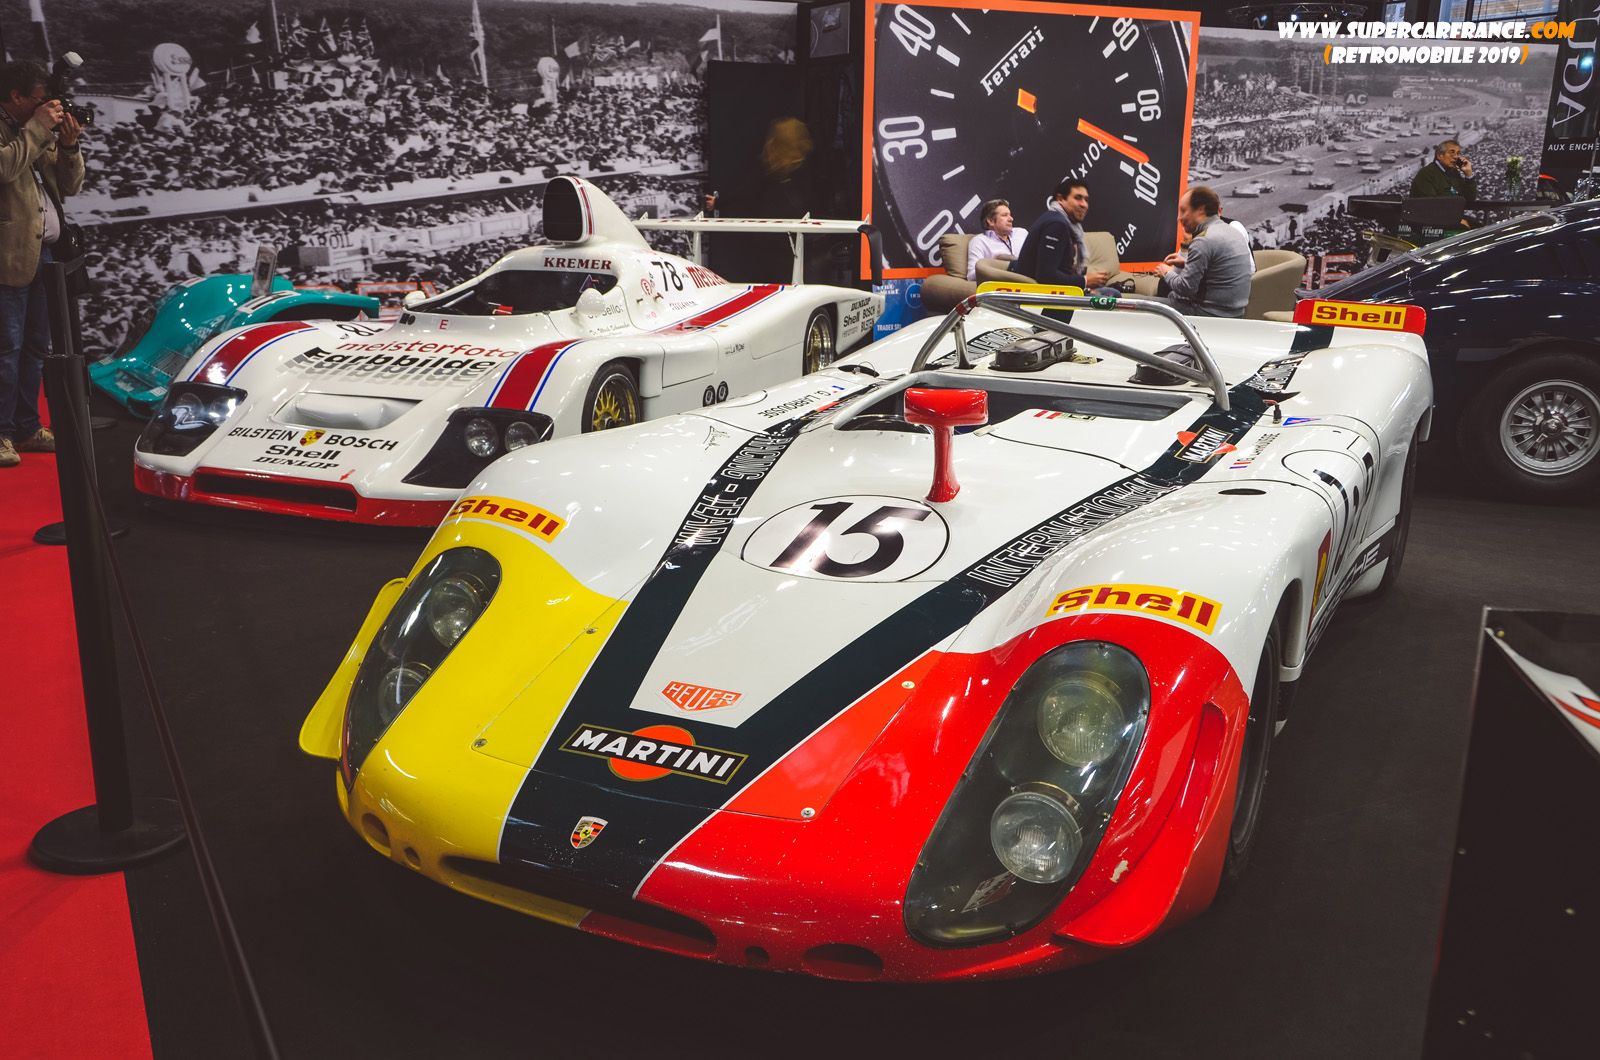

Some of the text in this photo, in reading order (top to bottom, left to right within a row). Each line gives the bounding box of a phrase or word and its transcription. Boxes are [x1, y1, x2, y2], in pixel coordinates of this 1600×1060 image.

[889, 4, 937, 57] 40
[980, 25, 1046, 97] Ferrari
[1137, 89, 1162, 122] 90
[1345, 93, 1367, 105] AC
[879, 116, 929, 163] 30
[1548, 143, 1566, 151] AUX
[1133, 162, 1161, 207] 100
[1116, 223, 1138, 255] GLIA
[543, 257, 612, 271] KREMER
[651, 261, 684, 293] 78
[439, 319, 449, 330] E
[843, 311, 860, 328] Shell
[1315, 305, 1402, 325] Shell
[301, 346, 497, 370] Farbbilde
[336, 340, 520, 359] meisterfoto
[227, 426, 399, 451] BILSTEIN BOSCH
[265, 444, 342, 461] Shell
[1181, 427, 1229, 462] MARTINI
[252, 456, 340, 470] DUNLOP
[449, 498, 560, 537] Shell
[674, 494, 748, 547] TEAM
[769, 500, 933, 578] 15
[1052, 586, 1215, 628] Shell
[665, 683, 737, 711] HEUER
[571, 728, 736, 778] MARTINI
